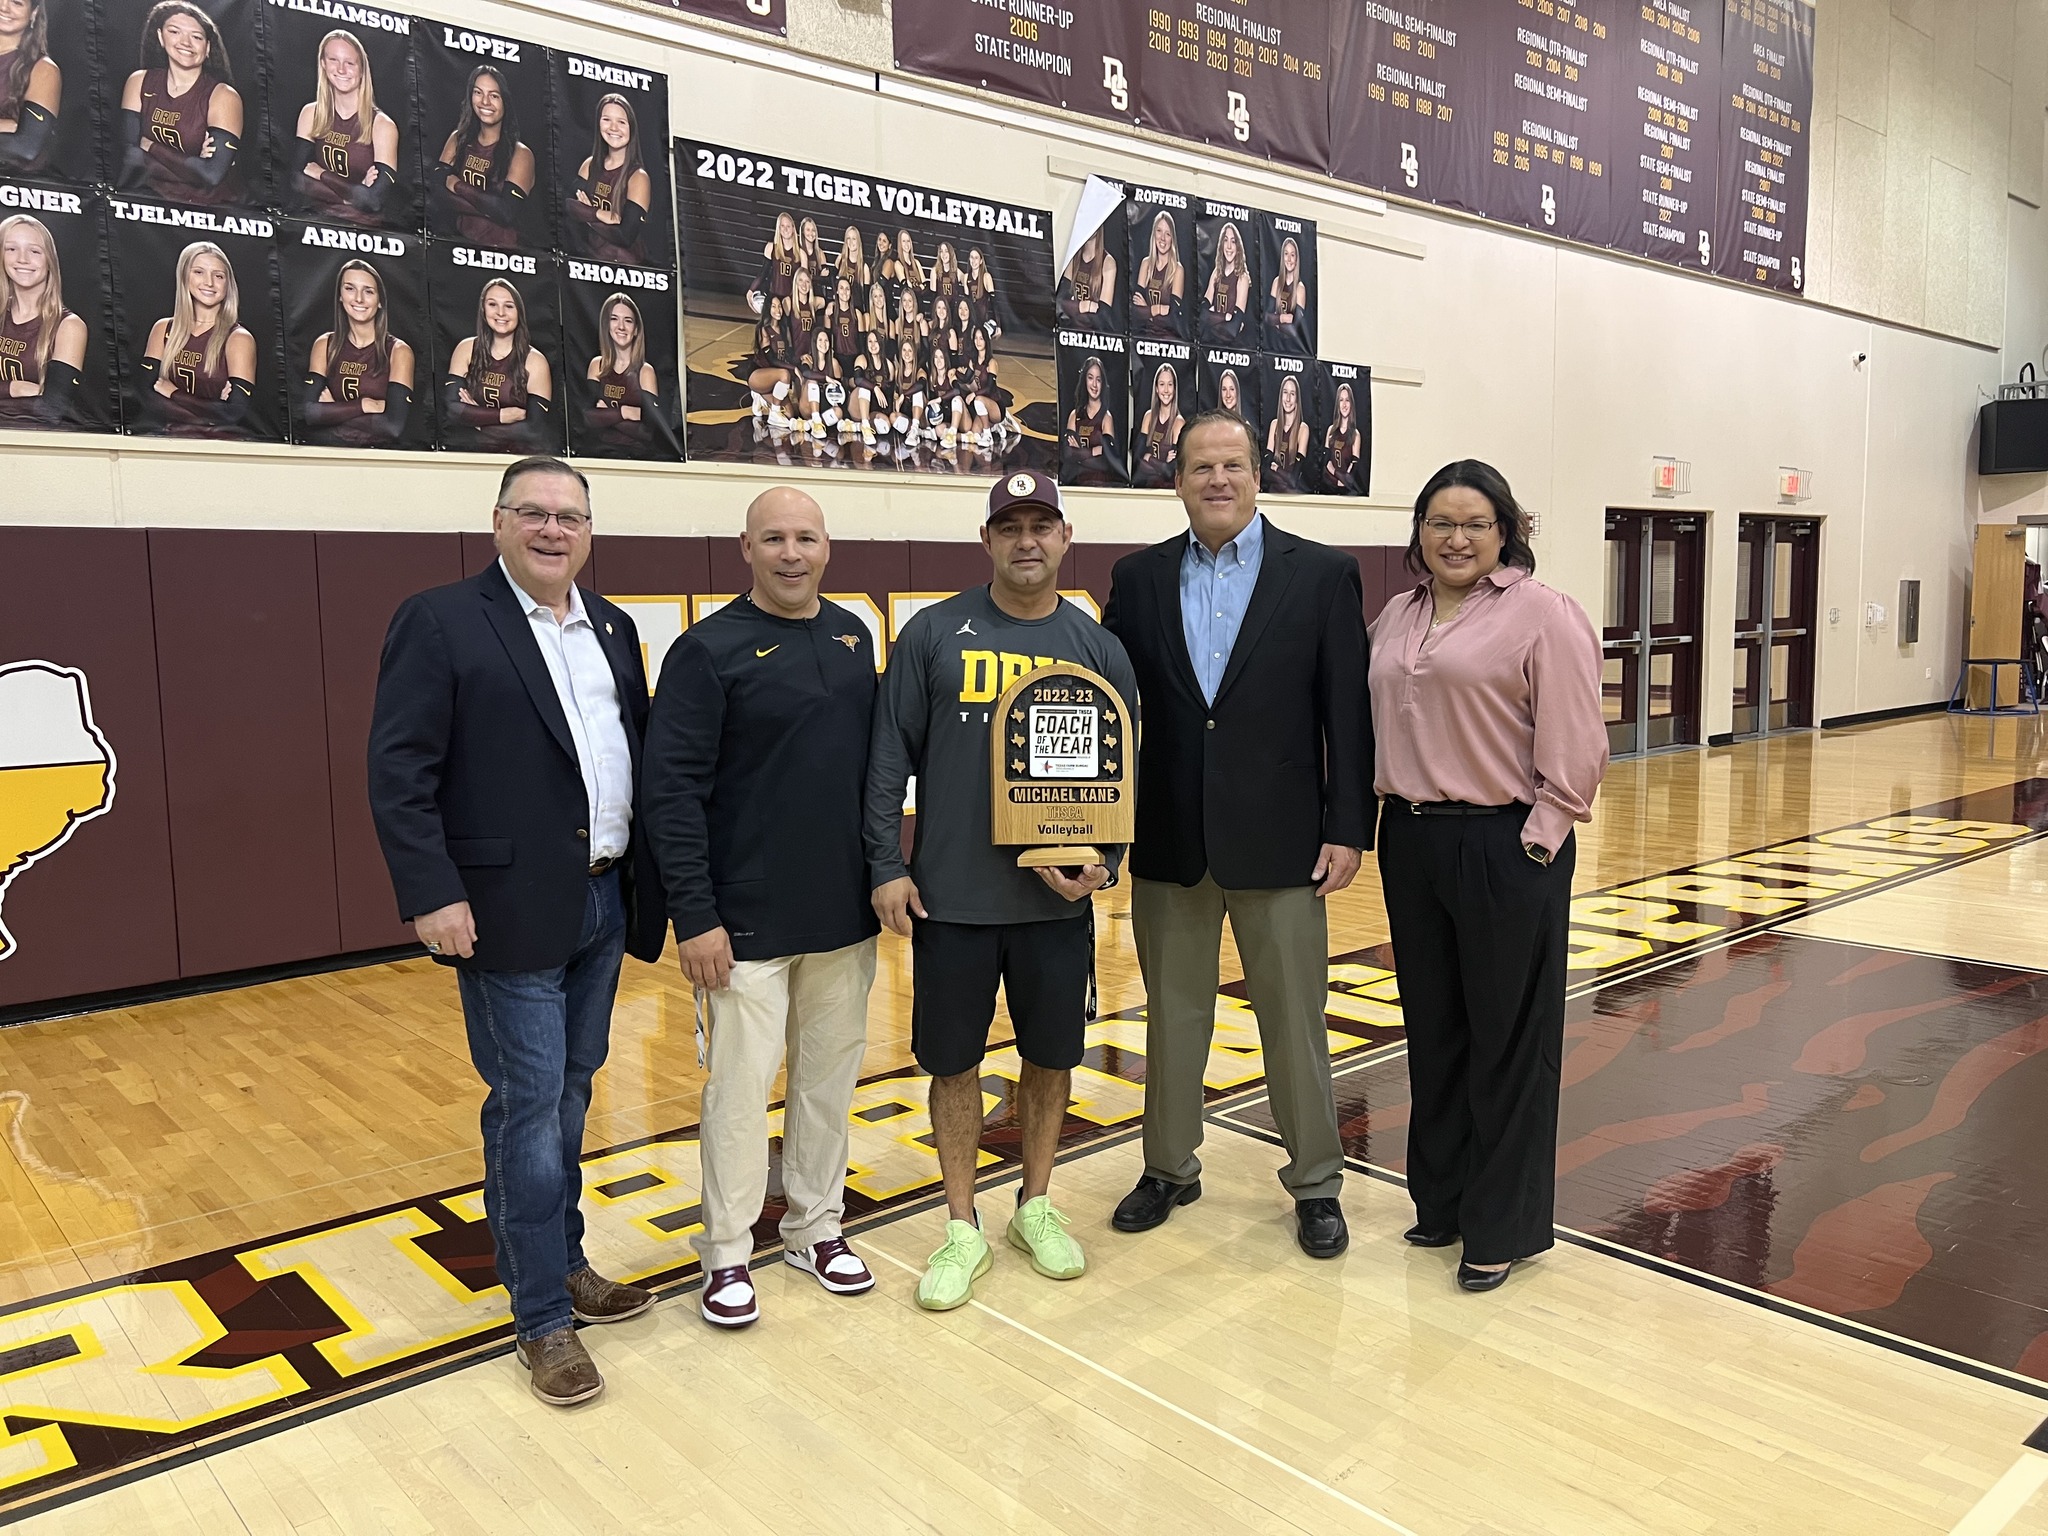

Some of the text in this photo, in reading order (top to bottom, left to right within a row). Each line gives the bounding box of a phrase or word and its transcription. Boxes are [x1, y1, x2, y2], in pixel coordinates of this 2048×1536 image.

[1196, 2, 1282, 46] REGIONAL FINALIST
[1366, 1, 1457, 48] REGIONAL SEMI-FINALIST
[1668, 2, 1690, 23] FINALIST
[1009, 16, 1038, 42] 2006
[444, 27, 521, 63] LOPEZ
[975, 33, 1072, 77] STATE CHAMPION
[1149, 9, 1321, 81] 1990 1993 1994 2004 2013 2014 2015
[1149, 31, 1252, 78] 2018 2019 2020 2021
[1392, 31, 1436, 60] 1985 2001
[1517, 27, 1588, 68] REGIONAL QTR-FINALIST
[1640, 38, 1699, 75] REGIONAL QTR-FINALIST
[1766, 48, 1785, 67] FINALIST
[567, 57, 652, 91] DEMENT
[1376, 62, 1446, 100] REGIONAL FINALIST
[1368, 82, 1453, 123] 1969 1986 1988 2017
[1514, 73, 1588, 112] REGIONAL SEMI-FINALIST
[1637, 86, 1699, 121] REGIONAL SEMI-FINALIST
[1743, 83, 1764, 103] REGIONAL
[152, 107, 181, 126] DRIP
[1493, 131, 1509, 148] 1993
[1514, 137, 1529, 154] 1994
[1534, 143, 1549, 160] 1995
[1552, 149, 1565, 165] 1997
[1522, 119, 1578, 151] REGIONAL FINALIST
[1643, 122, 1691, 152] REGIONAL FINALIST
[323, 146, 349, 177] 18
[465, 154, 490, 173] DRIP
[1493, 149, 1509, 166] 2002
[1640, 154, 1692, 183] STATE SEMI-FINALIST
[0, 184, 82, 215] GNER
[696, 149, 1044, 240] 2022 TIGER VOLLEYBALL
[1134, 188, 1187, 209] ROFFERS
[1642, 188, 1688, 214] STATE RUNNER-UP
[1741, 188, 1756, 204] STATE
[110, 200, 274, 238] TJELMELAND
[1206, 202, 1249, 221] EUSTON
[1275, 218, 1302, 234] KUHN
[1643, 221, 1685, 245] STATE CHAMPION
[1743, 220, 1757, 235] STATE
[301, 226, 405, 257] ARNOLD
[452, 247, 536, 275] SLEDGE
[1743, 249, 1757, 265] STATE
[568, 261, 669, 291] RHOADES
[1060, 331, 1124, 353] GRIJALVA
[1136, 341, 1190, 360] CERTAIN
[340, 361, 367, 376] DRIP
[1208, 350, 1250, 367] ALFORD
[1274, 357, 1304, 373] LUND
[1332, 364, 1358, 379] KEIM
[1033, 689, 1093, 703] 2022-23
[1035, 715, 1092, 734] COACH
[1035, 736, 1092, 754] THE YEAR
[1037, 736, 1047, 744] OF
[1014, 788, 1115, 802] MICHAEL KANE
[1046, 806, 1084, 819] THSCA
[1037, 824, 1093, 837] Volleyball
